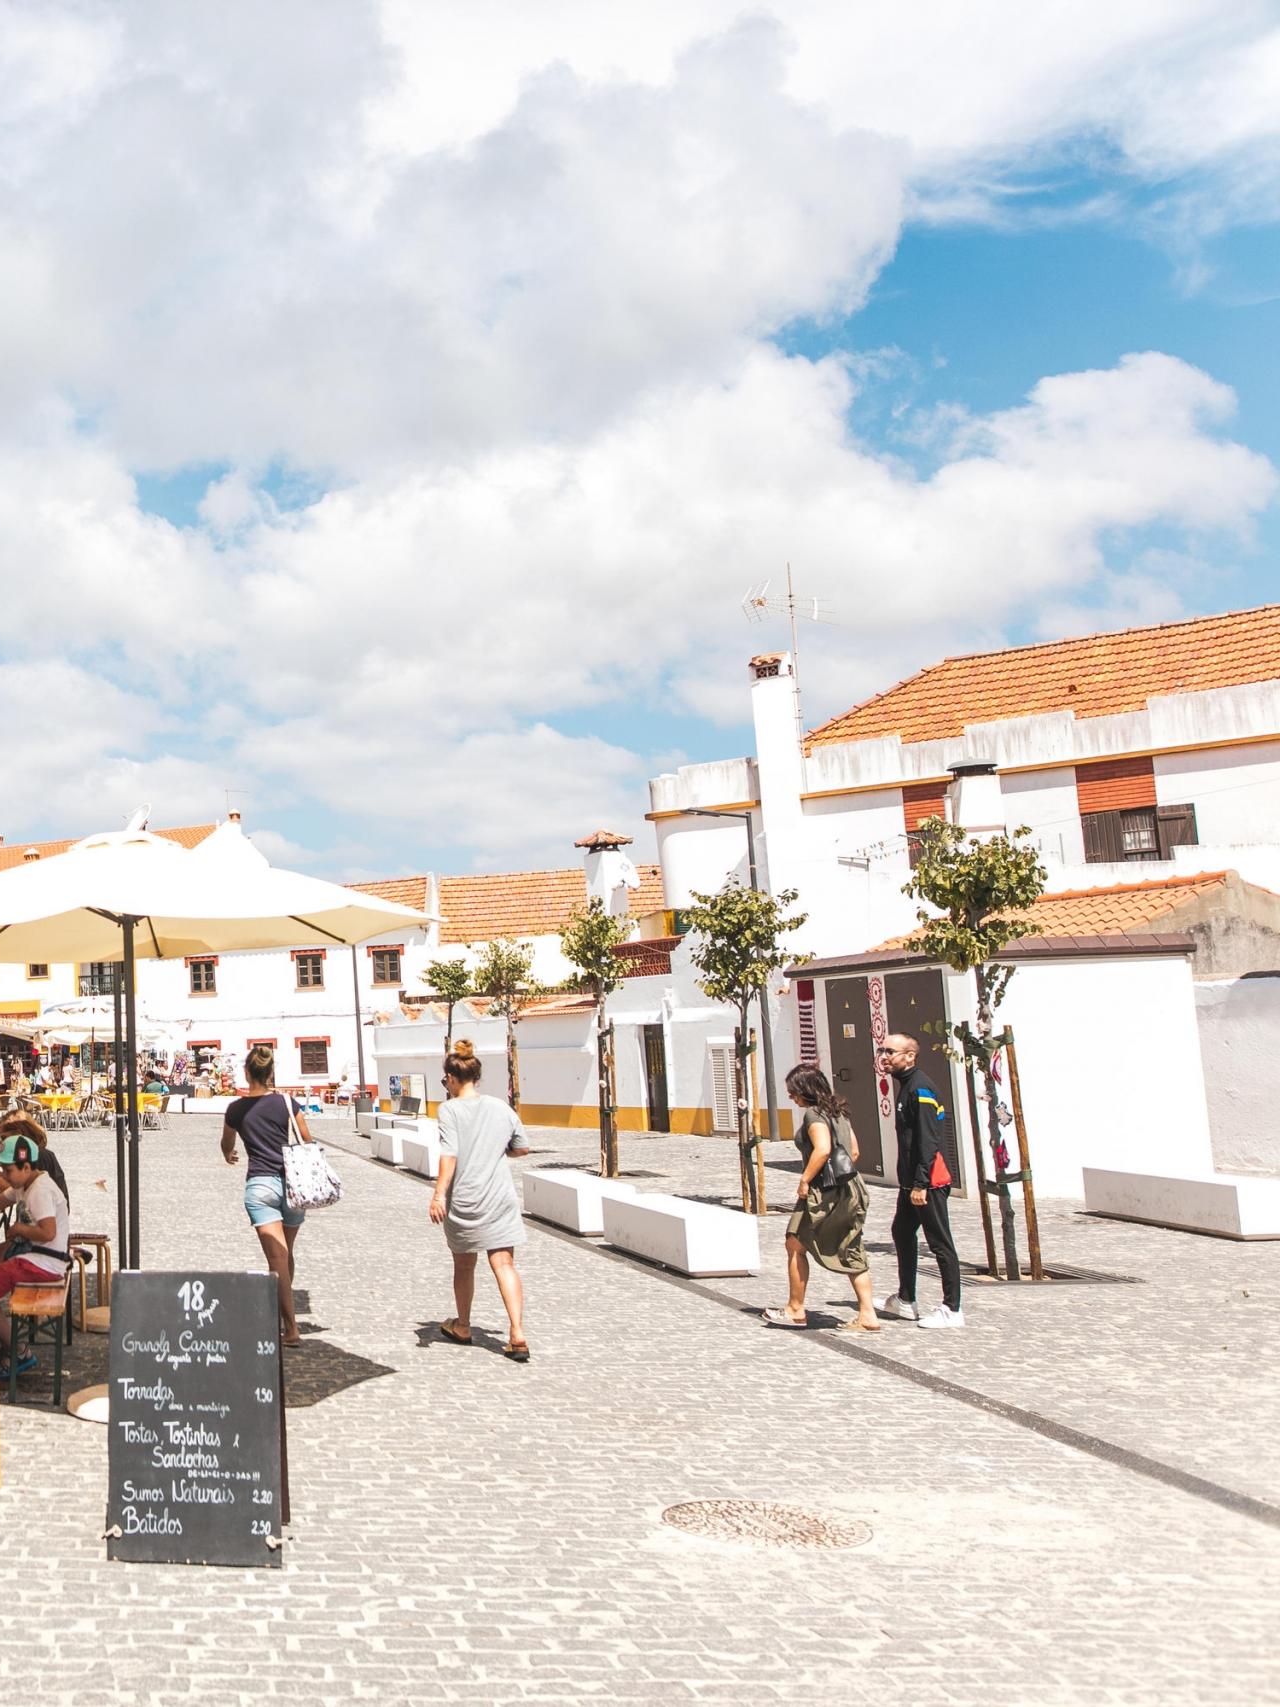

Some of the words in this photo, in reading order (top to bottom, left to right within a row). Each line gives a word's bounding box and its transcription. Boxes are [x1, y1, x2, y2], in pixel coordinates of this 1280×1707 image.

[177, 1280, 204, 1311] 18
[122, 1330, 170, 1354] Granola
[117, 1377, 175, 1402] Torradas
[162, 1421, 221, 1447] Tostinhas
[121, 1480, 165, 1502] Sumos
[172, 1479, 235, 1504] Naturais
[122, 1505, 183, 1536] Batidos
